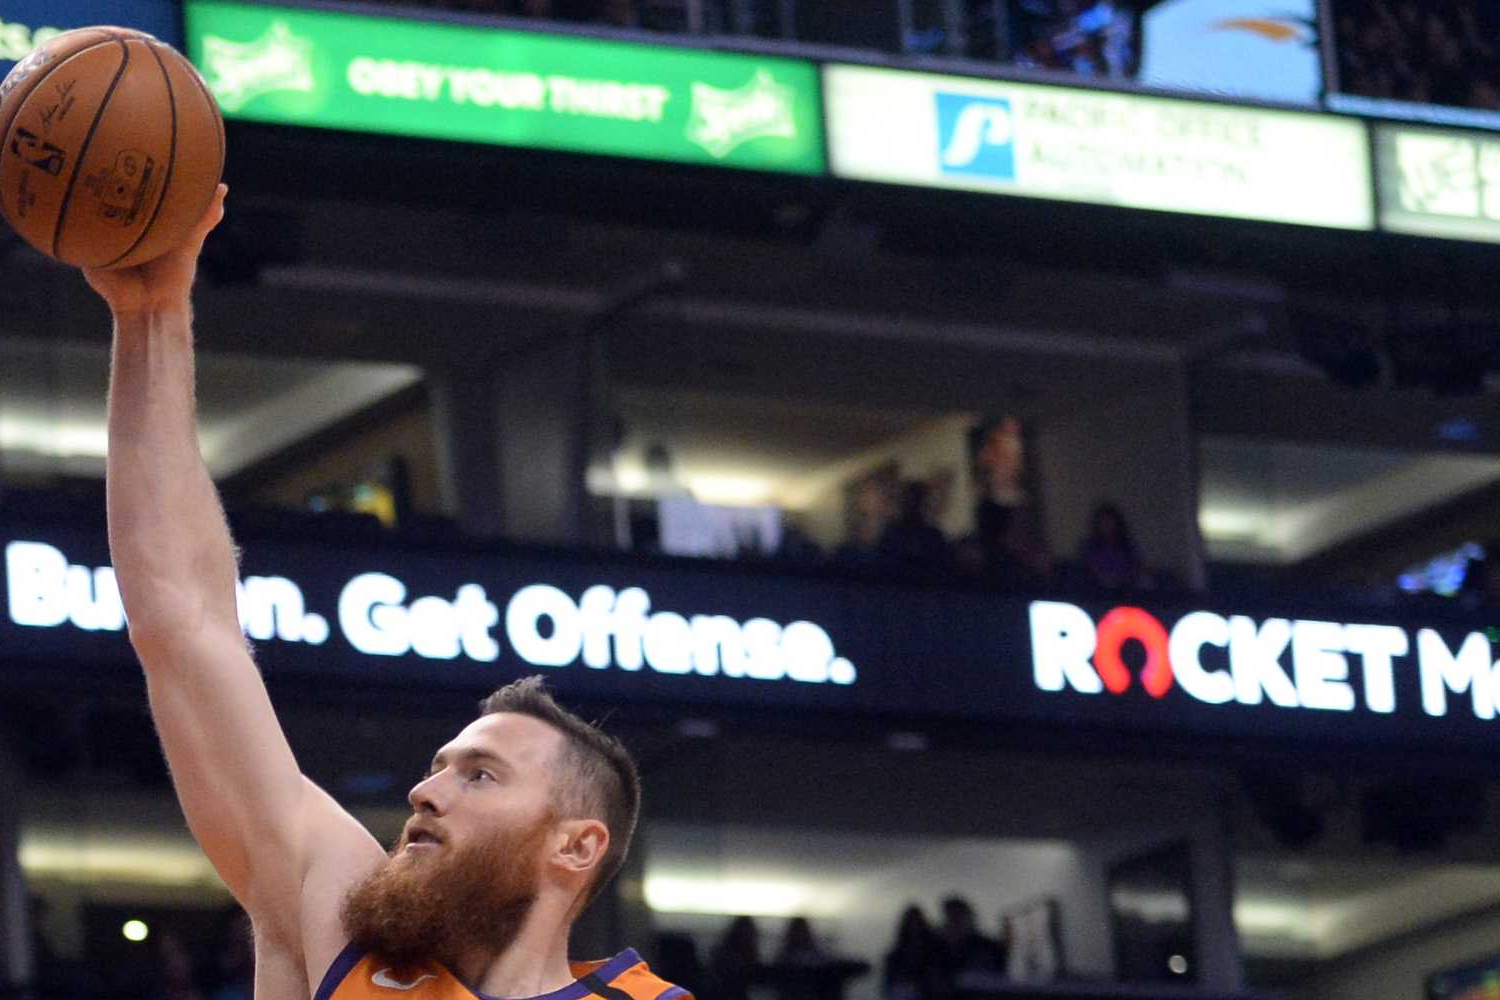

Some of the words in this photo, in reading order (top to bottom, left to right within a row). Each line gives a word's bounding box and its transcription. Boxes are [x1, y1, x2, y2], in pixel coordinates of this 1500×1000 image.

[6, 541, 329, 645] Bun.
[338, 573, 499, 662] Get
[506, 584, 856, 684] Offense.
[1417, 627, 1500, 720] M
